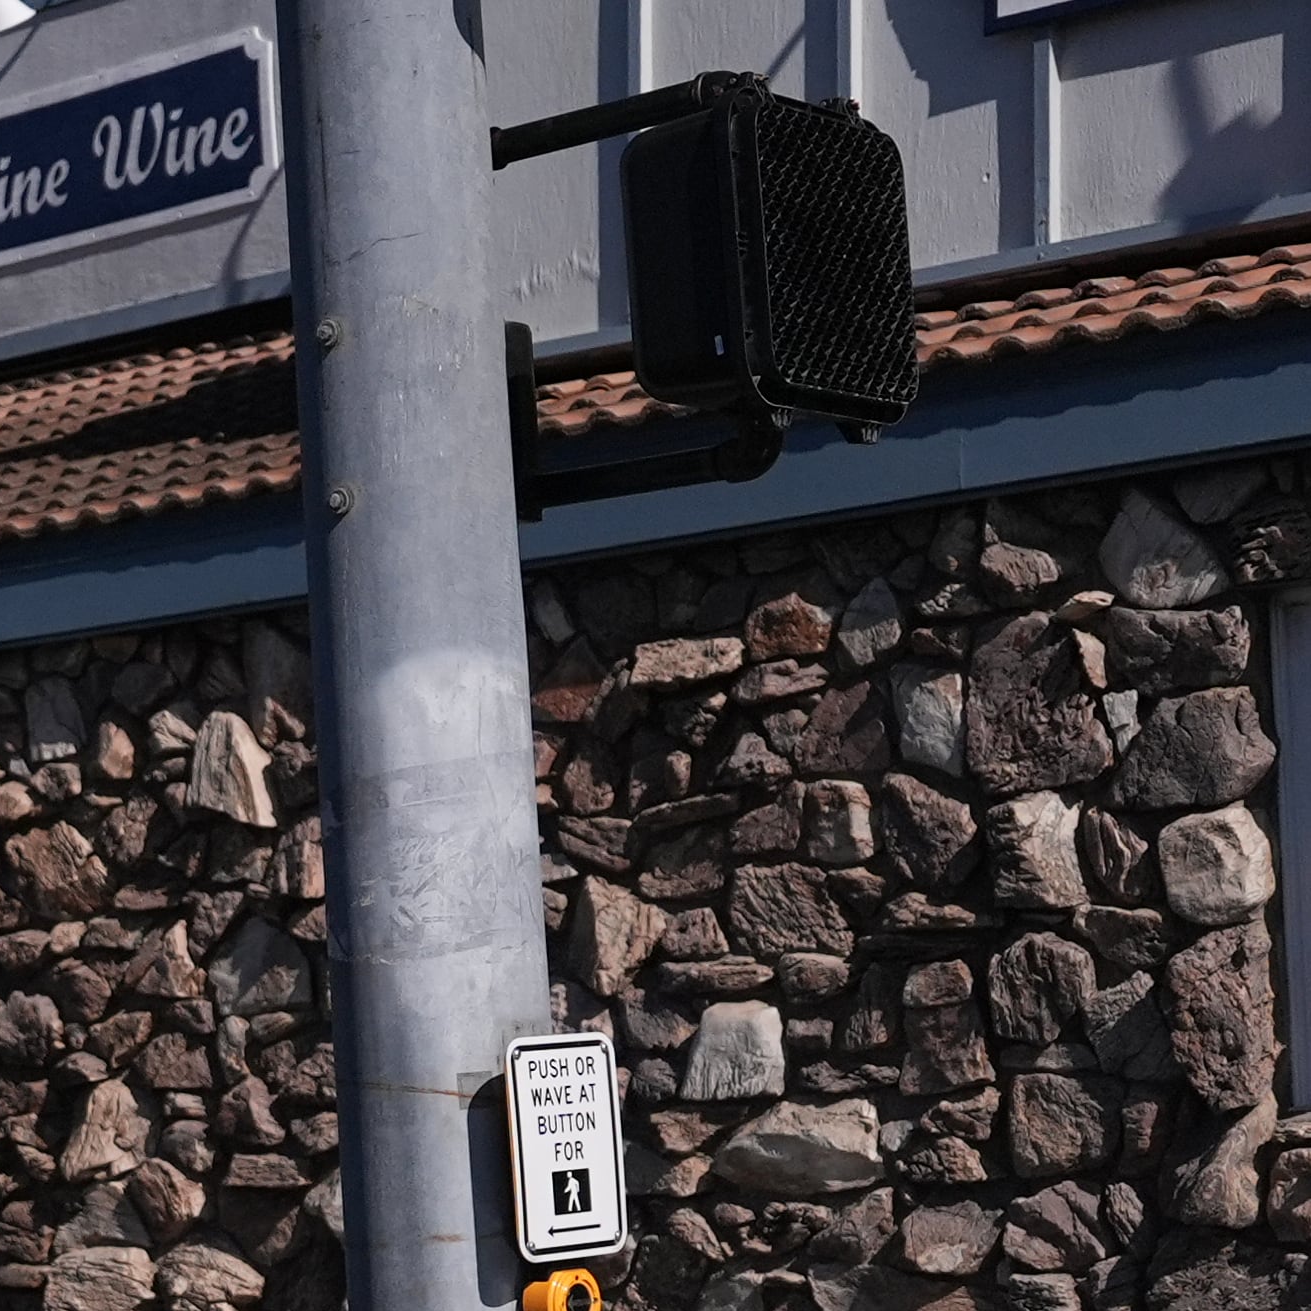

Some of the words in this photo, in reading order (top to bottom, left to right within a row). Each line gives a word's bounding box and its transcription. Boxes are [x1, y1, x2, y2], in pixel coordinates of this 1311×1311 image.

[92, 102, 255, 191] Wine
[528, 1058, 569, 1080] PUSH
[575, 1056, 596, 1076] OR
[531, 1086, 572, 1107] WAVE
[579, 1083, 596, 1103] AT
[538, 1111, 596, 1135] BUTTON
[554, 1141, 584, 1161] FOR
